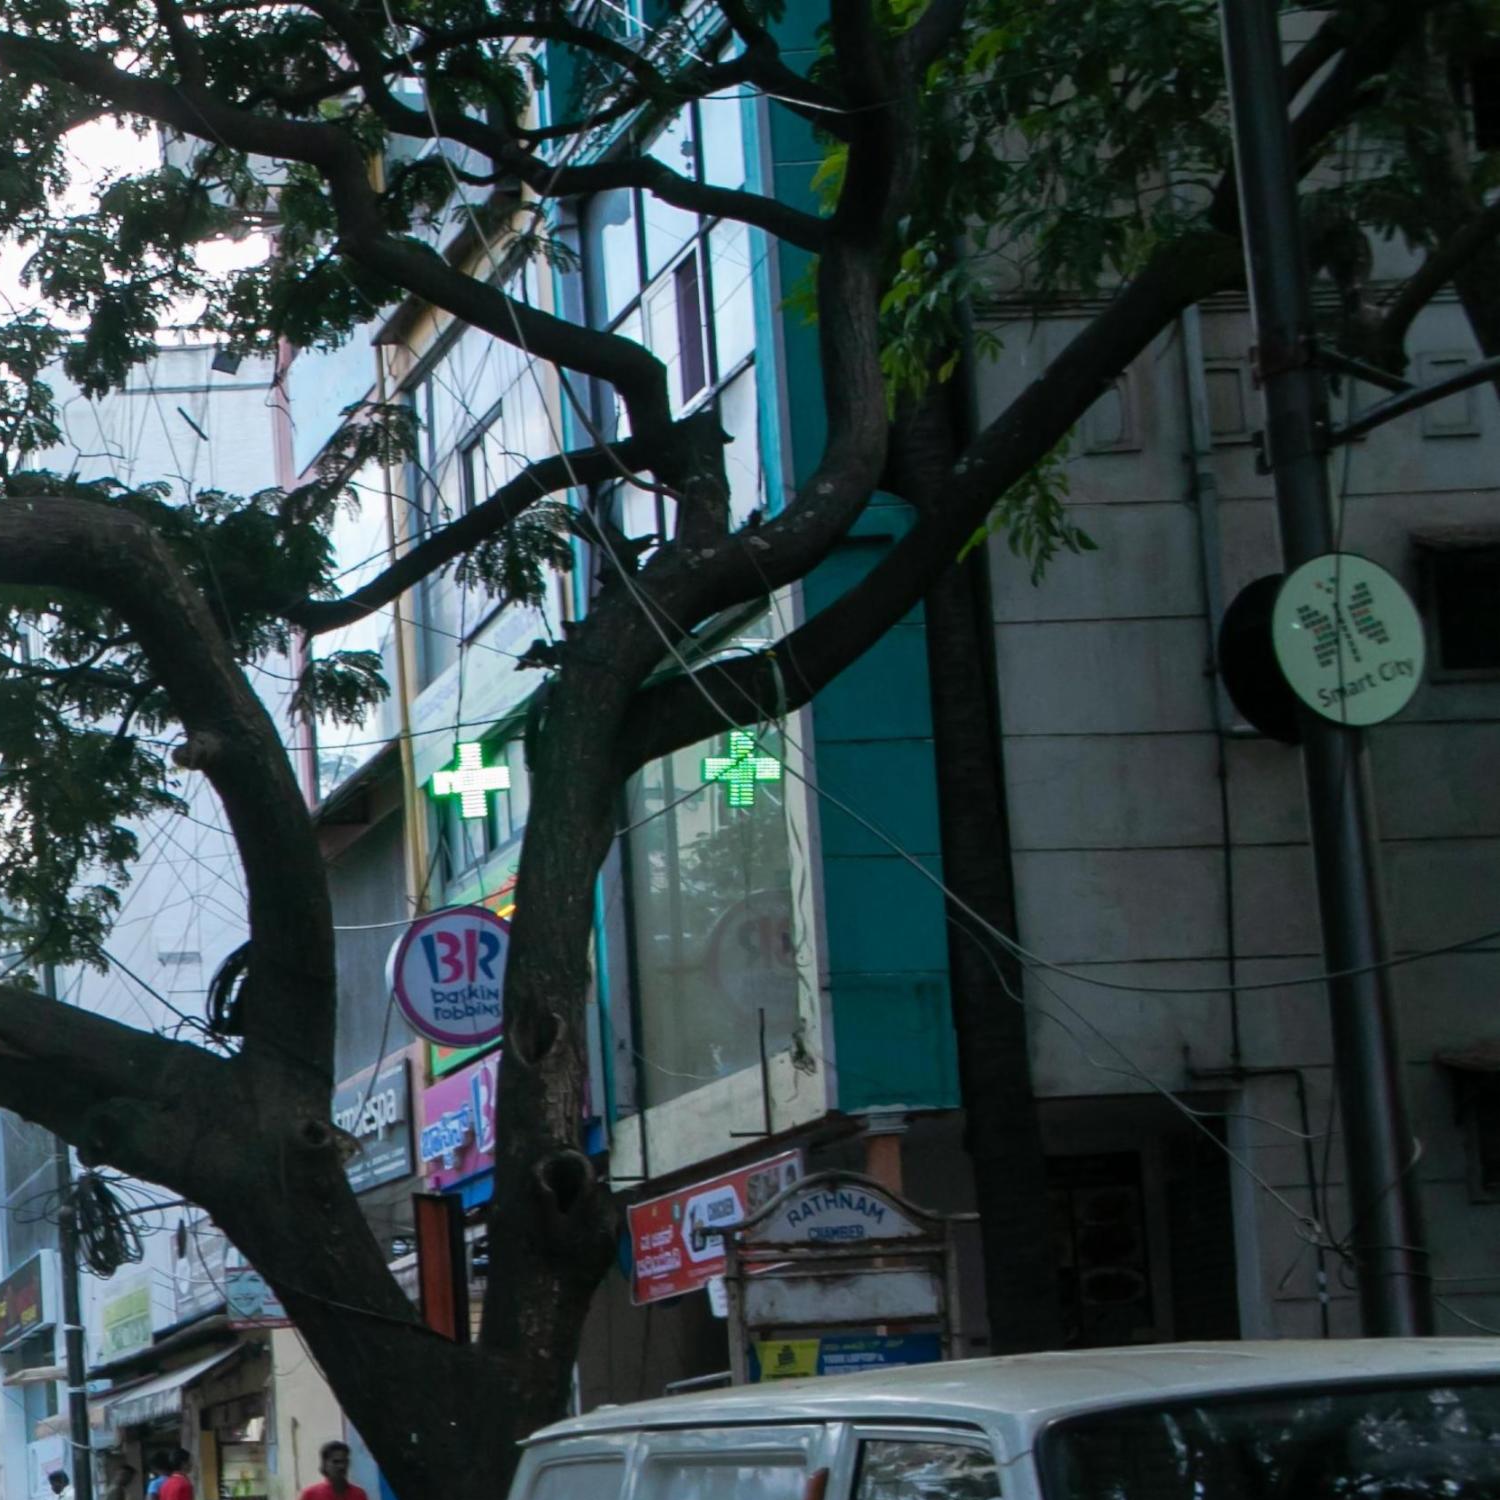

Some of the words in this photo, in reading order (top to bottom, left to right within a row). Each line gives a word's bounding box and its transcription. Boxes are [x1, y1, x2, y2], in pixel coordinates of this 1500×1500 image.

[1316, 673, 1377, 708] Smart
[1378, 657, 1415, 682] City
[420, 929, 501, 984] BR
[431, 984, 499, 1004] baskin
[432, 1002, 501, 1021] robbins
[470, 1061, 497, 1153] B
[786, 1188, 886, 1227] RATHNAM
[807, 1224, 865, 1240] CHAMBER
